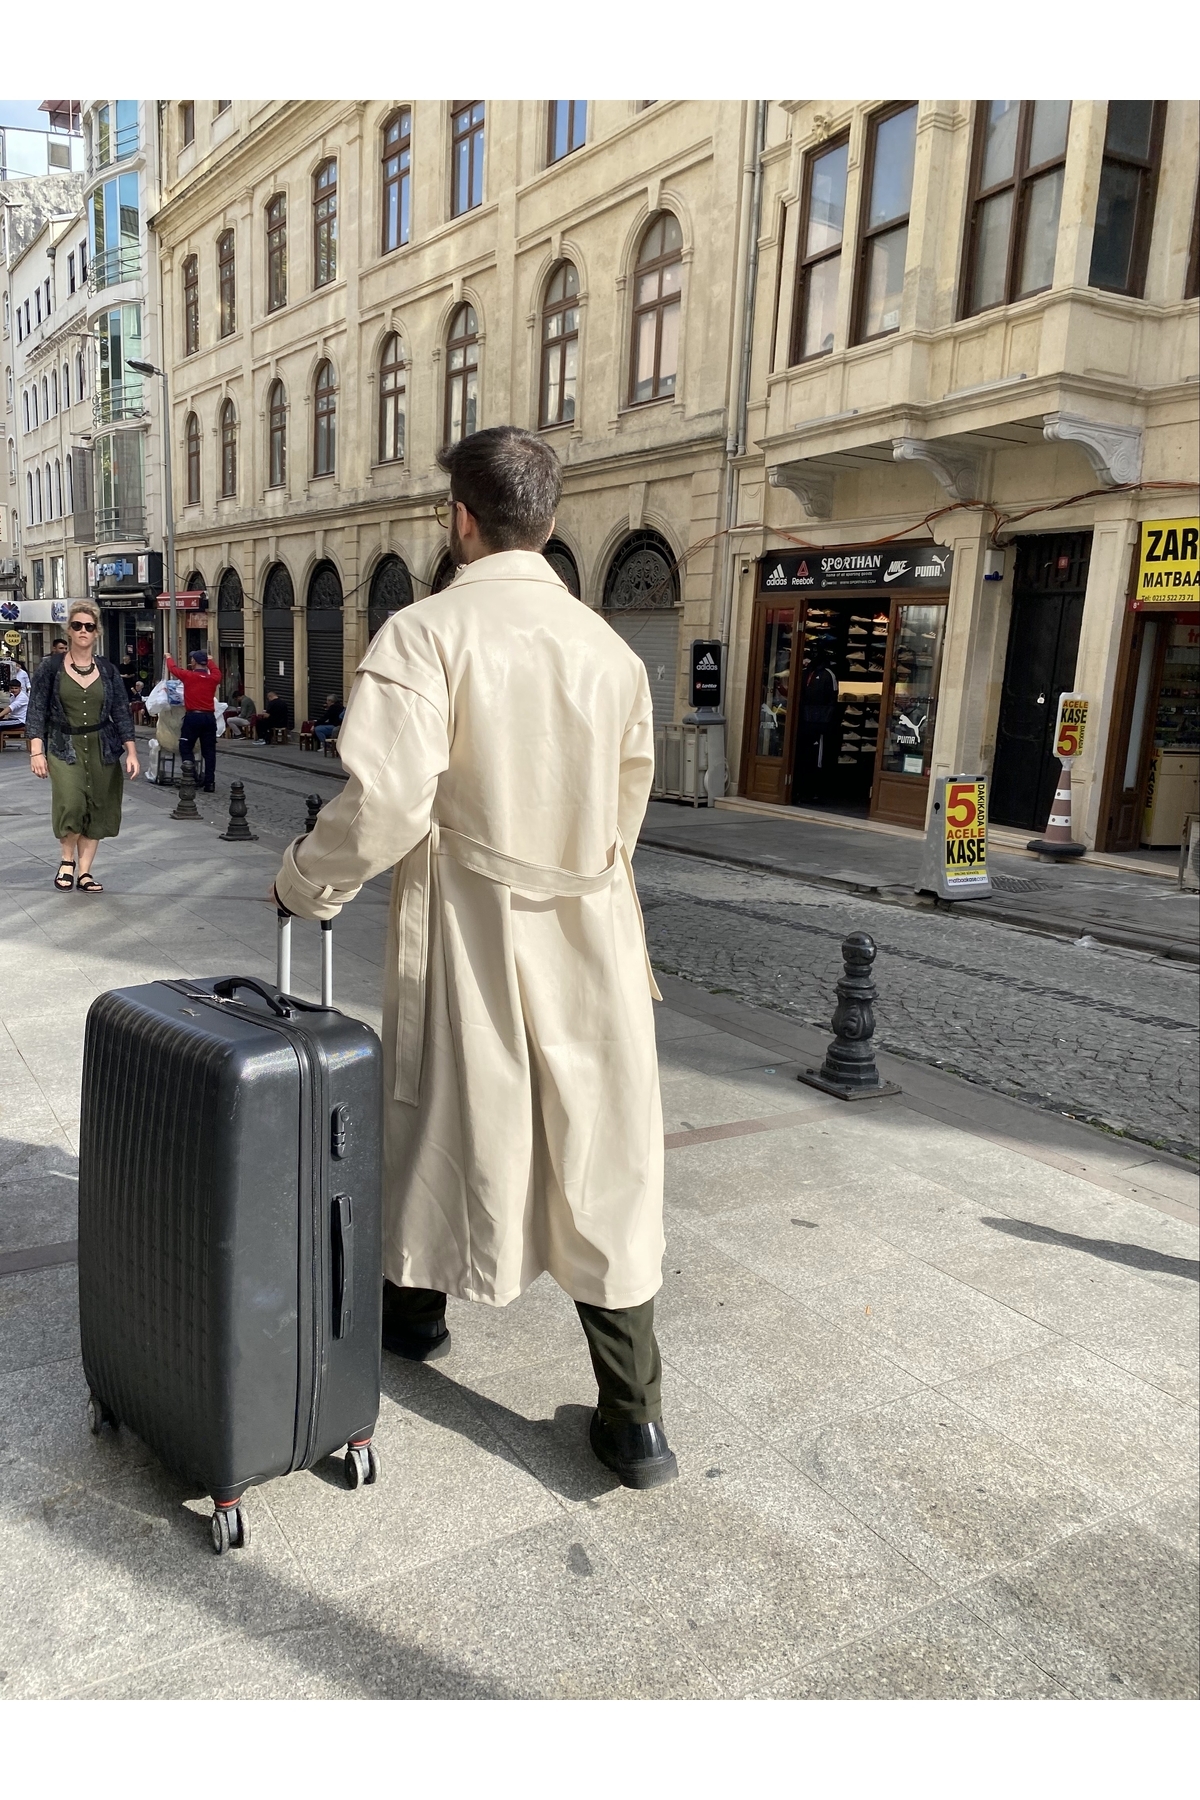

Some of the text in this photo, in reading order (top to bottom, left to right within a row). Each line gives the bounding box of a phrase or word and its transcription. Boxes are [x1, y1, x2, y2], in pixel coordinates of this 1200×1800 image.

[821, 555, 881, 572] SPORTHAN
[888, 560, 908, 572] NIKE
[915, 565, 941, 578] PUMA
[766, 576, 787, 586] adidas
[791, 577, 814, 586] Reebok
[1062, 700, 1088, 709] ACELE
[1061, 708, 1087, 725] KAŞE
[897, 735, 916, 745] PUMA
[1057, 725, 1078, 756] 5
[947, 784, 977, 828] 5
[946, 828, 985, 839] ACELE
[946, 839, 985, 867] KAŞE
